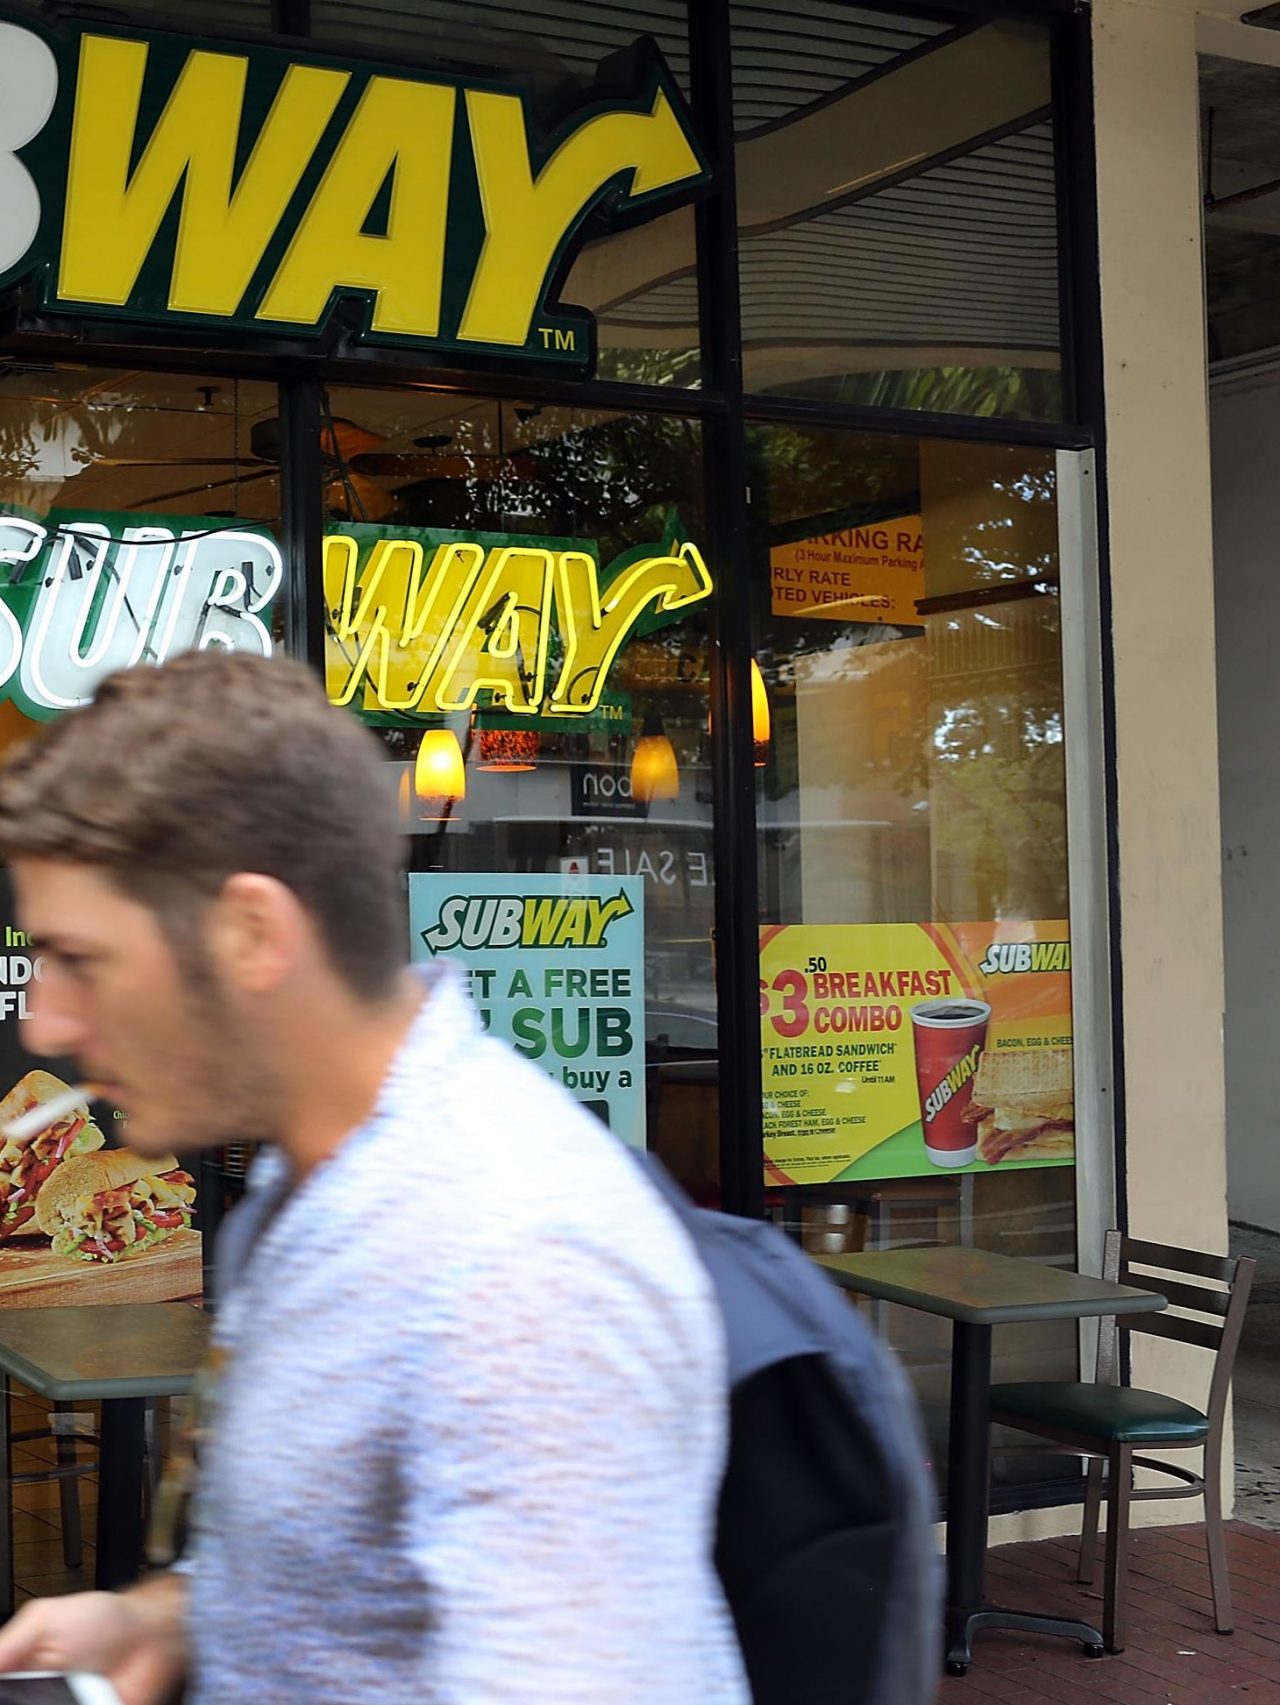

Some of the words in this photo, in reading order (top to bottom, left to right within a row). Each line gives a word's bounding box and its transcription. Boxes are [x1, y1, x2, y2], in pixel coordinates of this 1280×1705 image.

[538, 328, 575, 351] TM
[808, 529, 888, 549] KING
[807, 550, 831, 561] Hour
[834, 552, 879, 566] Maximum
[882, 555, 917, 572] Parking
[809, 571, 851, 586] RATE
[770, 587, 806, 601] TED
[422, 890, 633, 953] SUBWAY
[804, 957, 827, 973] .50
[507, 969, 533, 998] A
[545, 968, 632, 998] FREE
[813, 970, 951, 999] BREAKFAST
[814, 1004, 902, 1034] COMBO
[510, 1007, 633, 1059] SUB
[769, 1045, 833, 1059] FLATBREAD
[997, 1039, 1025, 1048] BACON,
[1027, 1038, 1041, 1047] EGG
[772, 1064, 797, 1076] AND
[801, 1063, 814, 1075] 16
[817, 1062, 834, 1074] OZ.
[838, 1060, 879, 1072] COFFEE
[563, 1066, 609, 1092] buy
[618, 1070, 632, 1088] a
[925, 1044, 980, 1122] SUBWAY
[774, 1090, 798, 1098] CHOICE
[777, 1100, 801, 1108] CHEESE
[802, 1109, 826, 1117] CHEESE
[779, 1120, 802, 1128] FOREST
[841, 1116, 867, 1125] CHEESE
